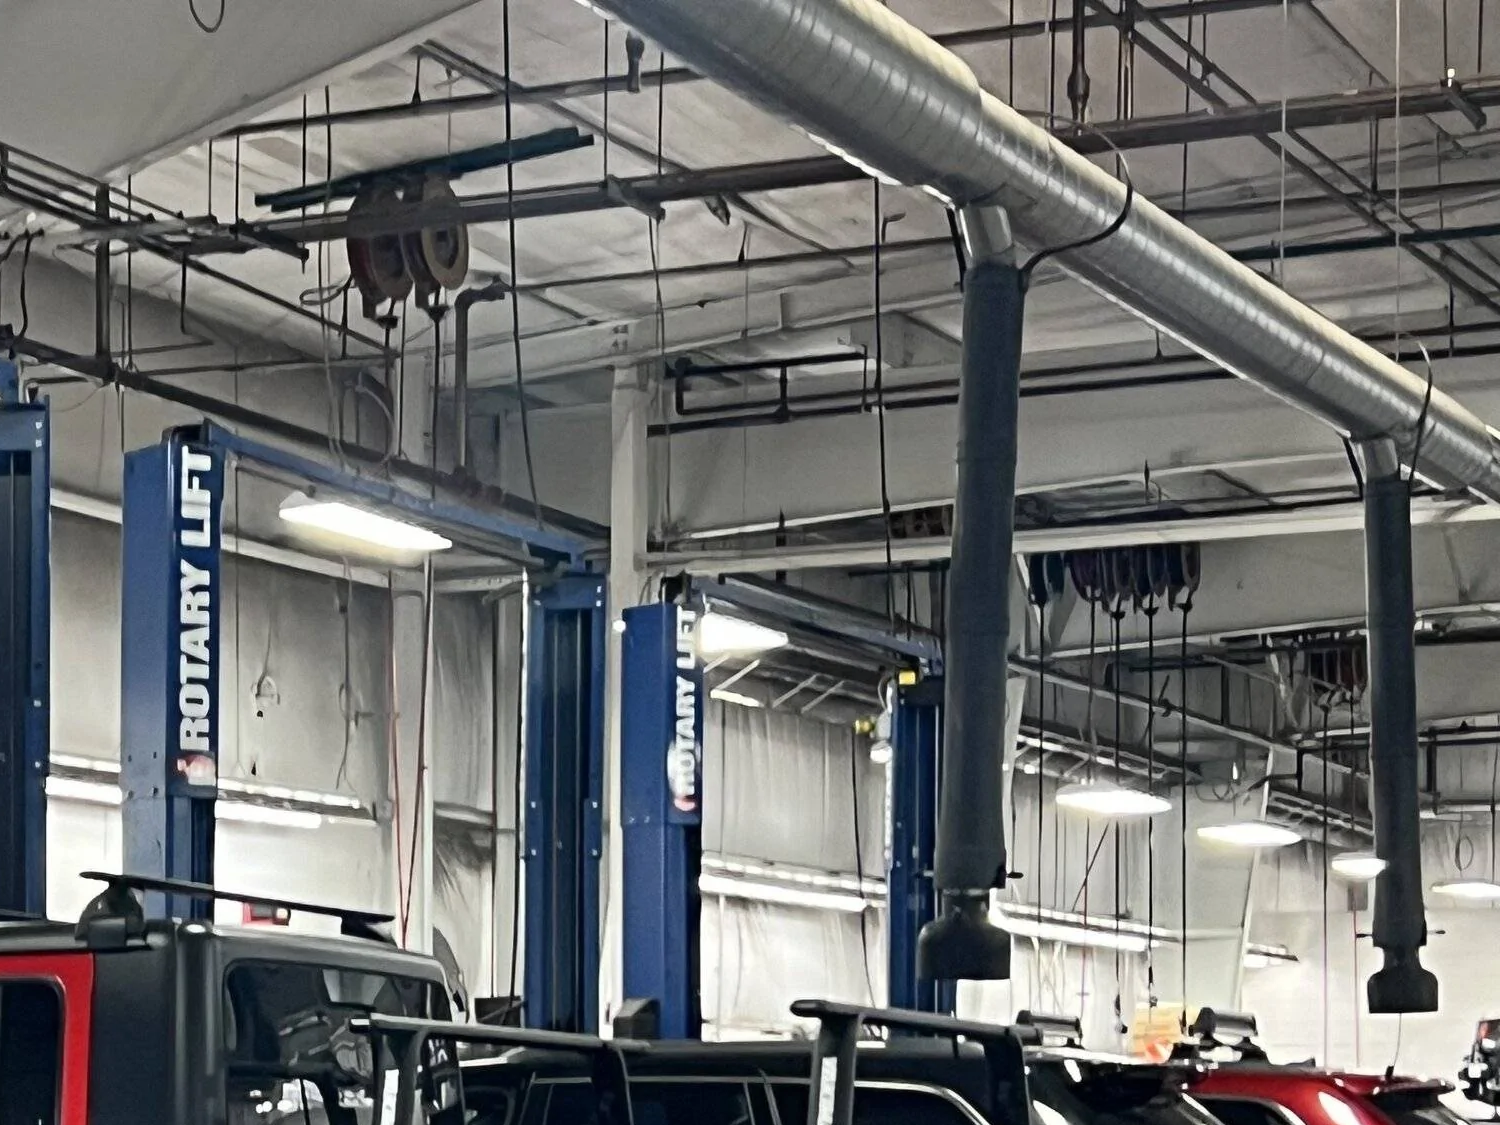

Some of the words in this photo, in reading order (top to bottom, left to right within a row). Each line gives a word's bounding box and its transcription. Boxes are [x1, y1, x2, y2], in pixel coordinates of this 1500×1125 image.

[181, 444, 212, 547] LIFT
[179, 558, 211, 751] ROTARY
[676, 604, 697, 670] LIFT
[675, 675, 696, 796] ROTARY
